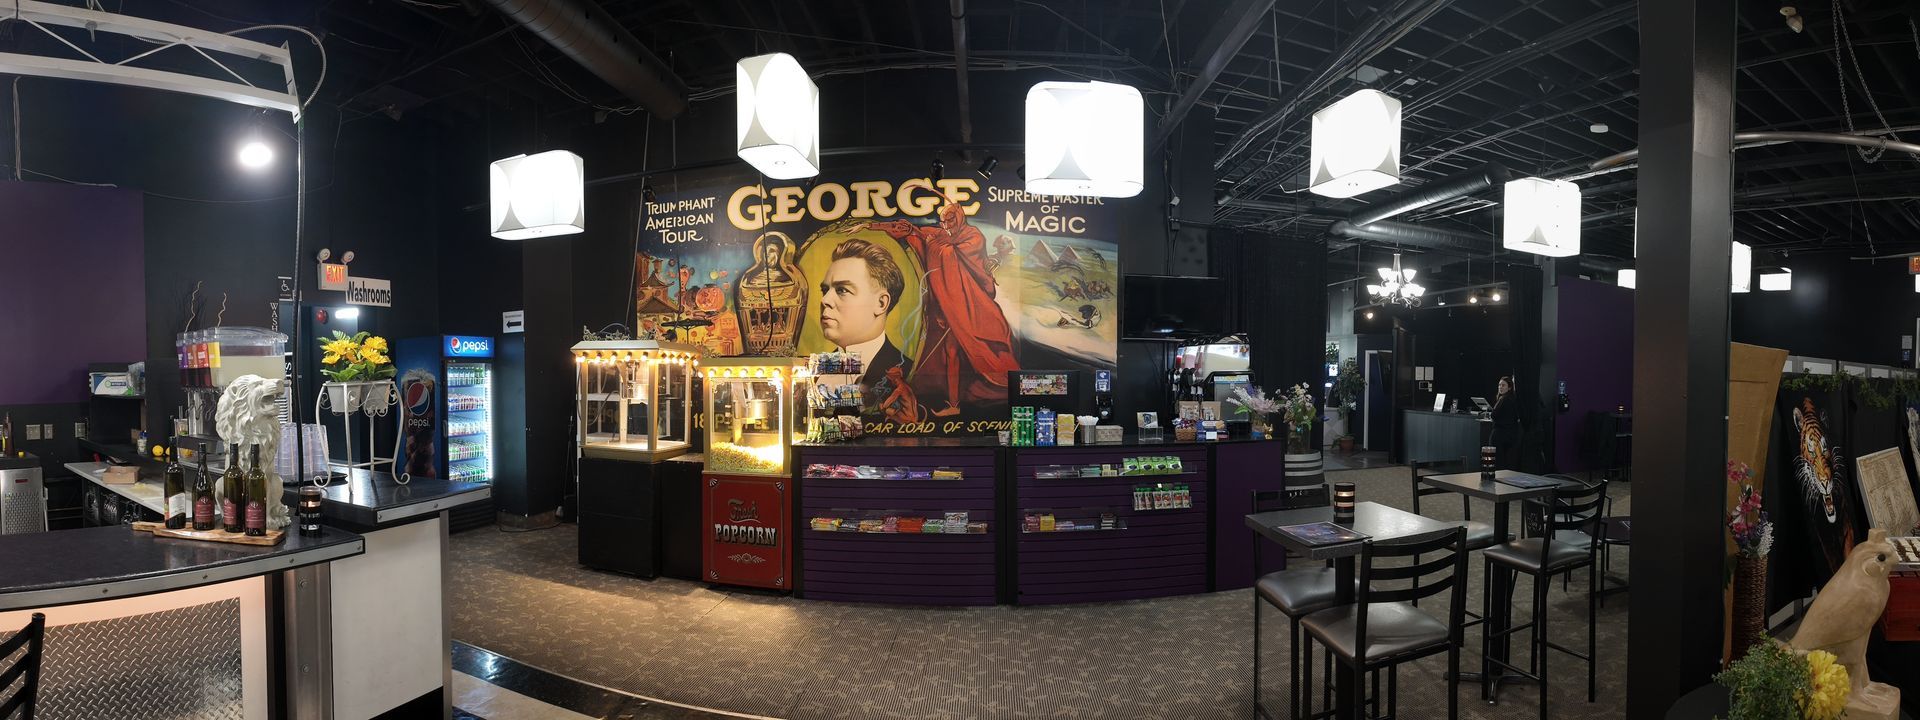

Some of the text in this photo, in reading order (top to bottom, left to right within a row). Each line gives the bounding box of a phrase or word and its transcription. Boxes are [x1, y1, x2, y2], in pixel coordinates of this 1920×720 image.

[988, 186, 1049, 203] SUPREME
[645, 197, 715, 216] TRIUMPHANT
[727, 178, 981, 230] GEORGE
[1041, 205, 1060, 213] OF
[645, 213, 714, 231] AMERICAN
[1005, 210, 1086, 234] MAGIC
[659, 229, 703, 244] TOUR
[326, 265, 344, 283] EXIT
[347, 281, 391, 304] Washrooms
[462, 340, 489, 352] pepsi
[408, 417, 430, 427] pepsi
[865, 421, 894, 434] CAR
[897, 421, 936, 434] LOAD
[943, 421, 964, 434] OF
[967, 420, 1013, 433] SCENI
[714, 523, 776, 546] POPCORN
